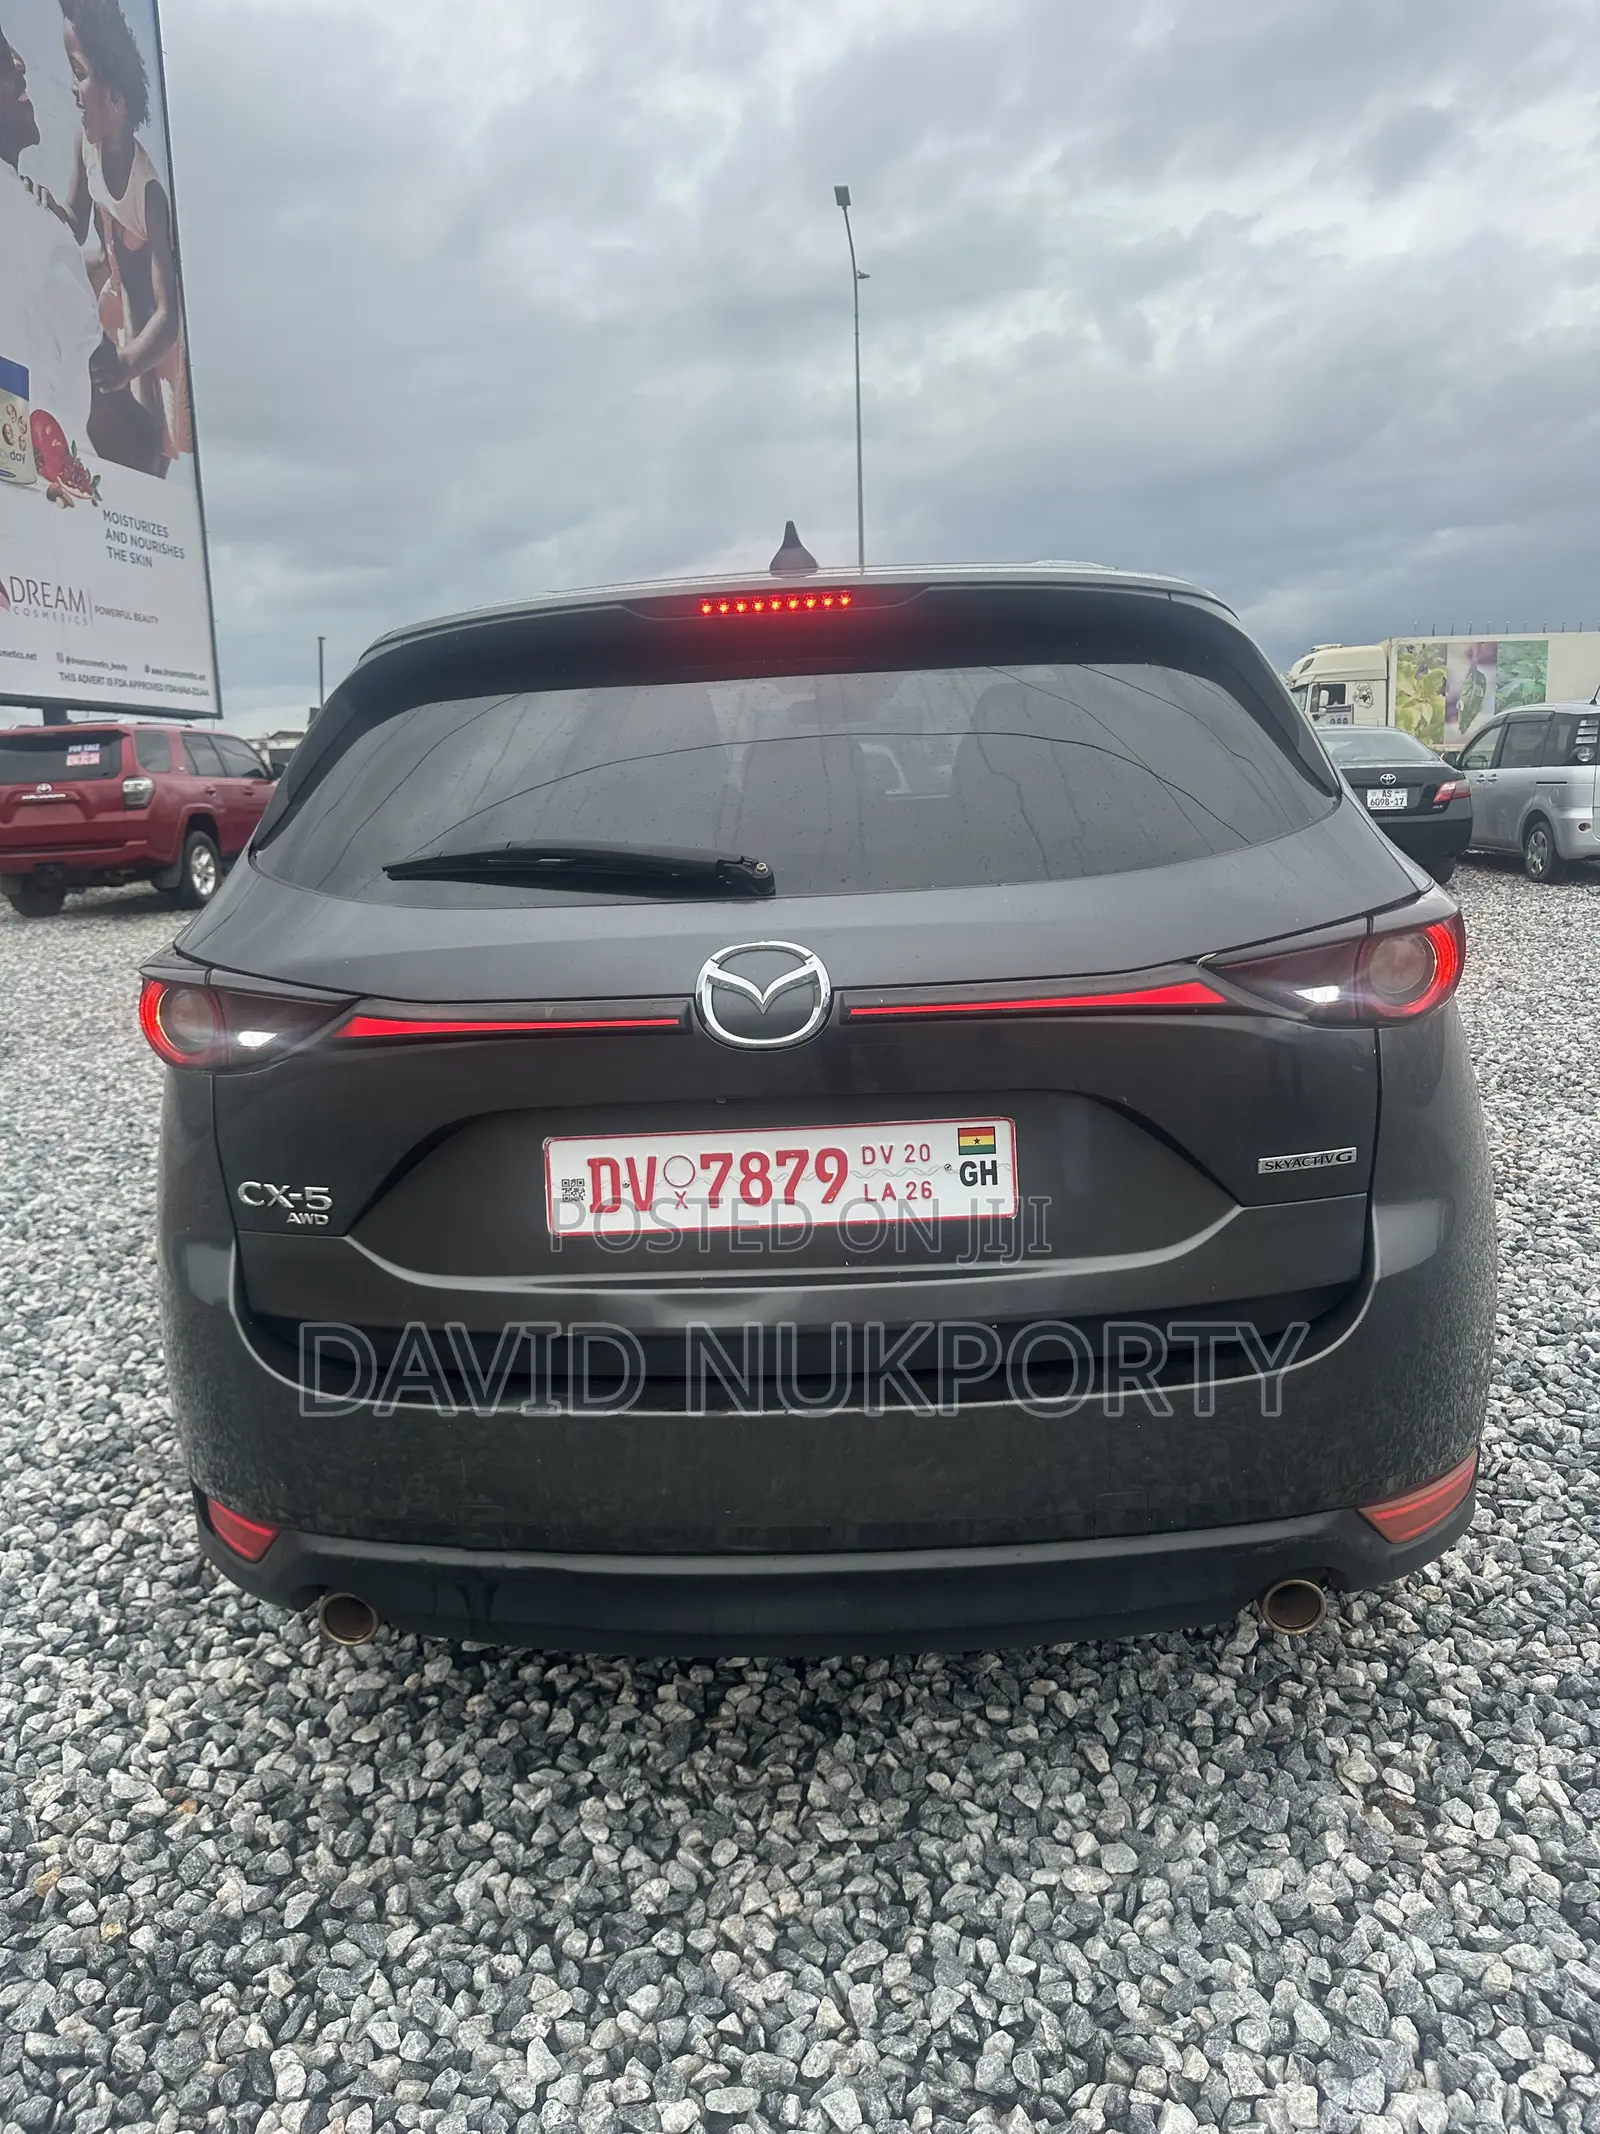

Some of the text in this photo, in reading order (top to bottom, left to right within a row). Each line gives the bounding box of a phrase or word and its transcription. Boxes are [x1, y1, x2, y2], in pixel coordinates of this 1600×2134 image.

[103, 509, 169, 538] MOISTURIZES
[105, 528, 185, 559] AND NOURISHES
[107, 546, 153, 568] THE SKIN
[10, 576, 87, 614] DREAM
[12, 606, 89, 627] COSMETICS
[95, 605, 159, 624] POWERFUL BEAUTY
[58, 671, 76, 683] THIS
[78, 673, 105, 686] ADVERT
[1382, 790, 1392, 798] AS
[861, 1143, 931, 1165] DV 20
[587, 1145, 848, 1214] DV 7879
[959, 1159, 998, 1187] GH
[238, 1181, 333, 1211] CX-5
[863, 1180, 933, 1202] LA 26
[286, 1212, 330, 1225] AWD
